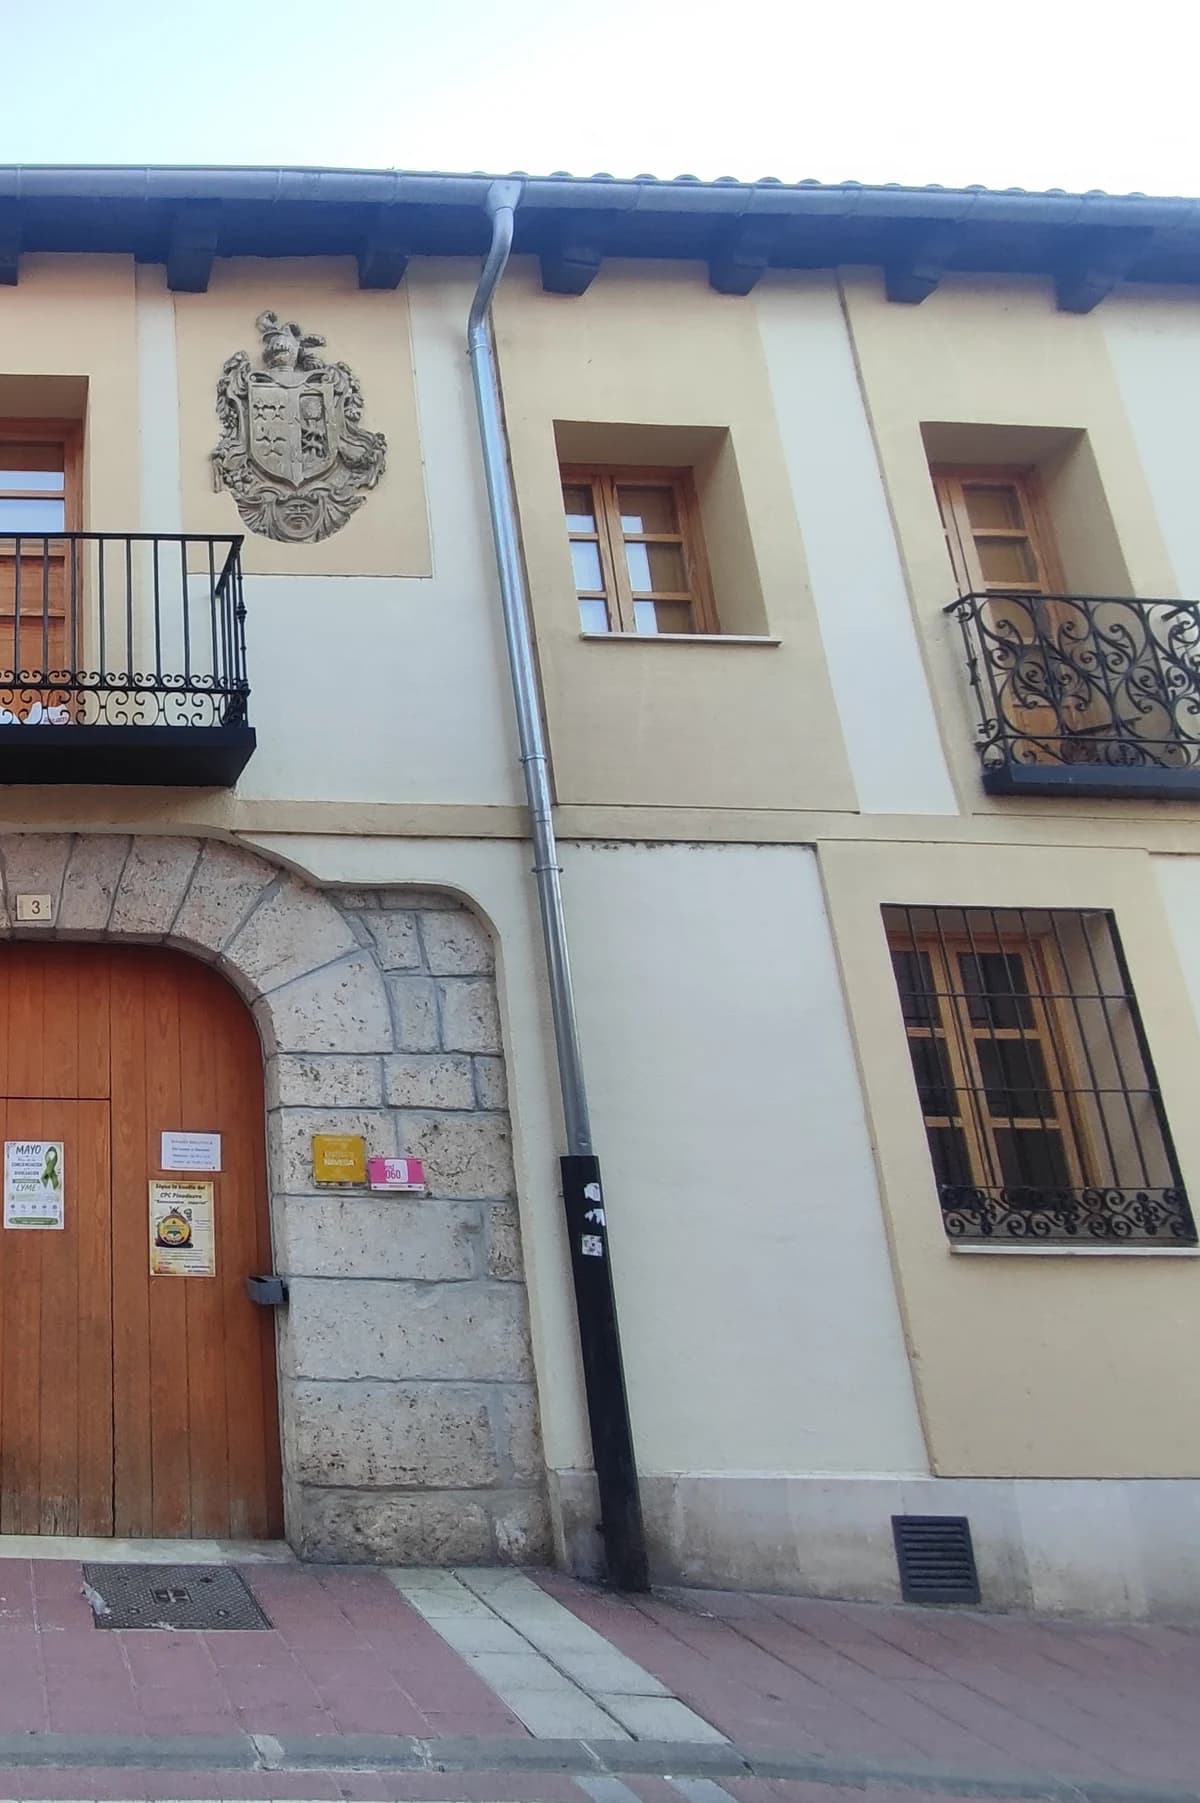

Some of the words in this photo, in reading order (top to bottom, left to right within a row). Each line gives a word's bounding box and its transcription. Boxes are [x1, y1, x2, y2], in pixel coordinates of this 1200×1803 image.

[31, 900, 40, 915] 3
[16, 1144, 42, 1155] MAYO
[385, 1169, 401, 1179] 060
[16, 1184, 37, 1192] LYME
